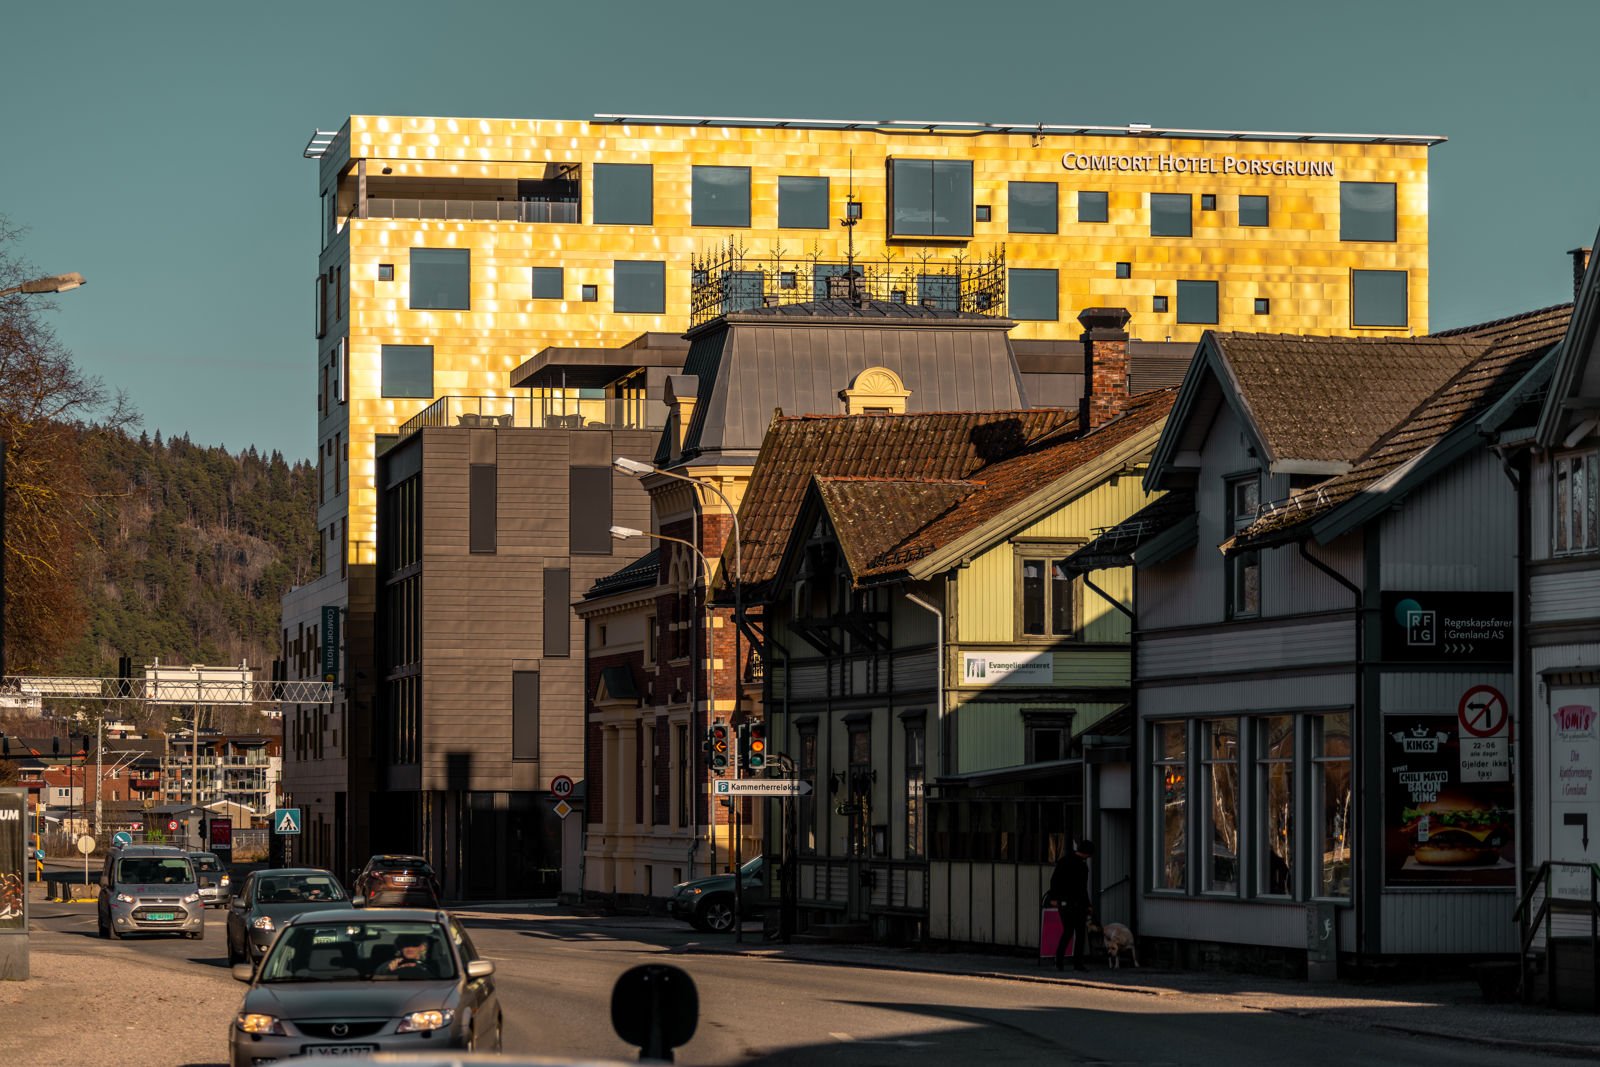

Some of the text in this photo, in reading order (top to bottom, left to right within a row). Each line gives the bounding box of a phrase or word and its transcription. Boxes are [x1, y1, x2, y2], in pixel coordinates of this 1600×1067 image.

[1062, 152, 1335, 177] COMFORT HOTEL PORSGRUNN
[1444, 617, 1513, 629] Regnskapsfører
[327, 608, 335, 669] COMFORT HOTEL
[1448, 630, 1490, 640] Grenland
[1491, 630, 1505, 640] AS
[1560, 708, 1590, 731] Tomi's
[1406, 740, 1435, 751] KINGS
[1462, 760, 1508, 769] Gjelder ikke
[1423, 772, 1447, 782] MAYO
[1478, 770, 1493, 778] taxi
[555, 781, 570, 793] 40
[1407, 782, 1441, 792] BACON
[1412, 791, 1437, 803] KING
